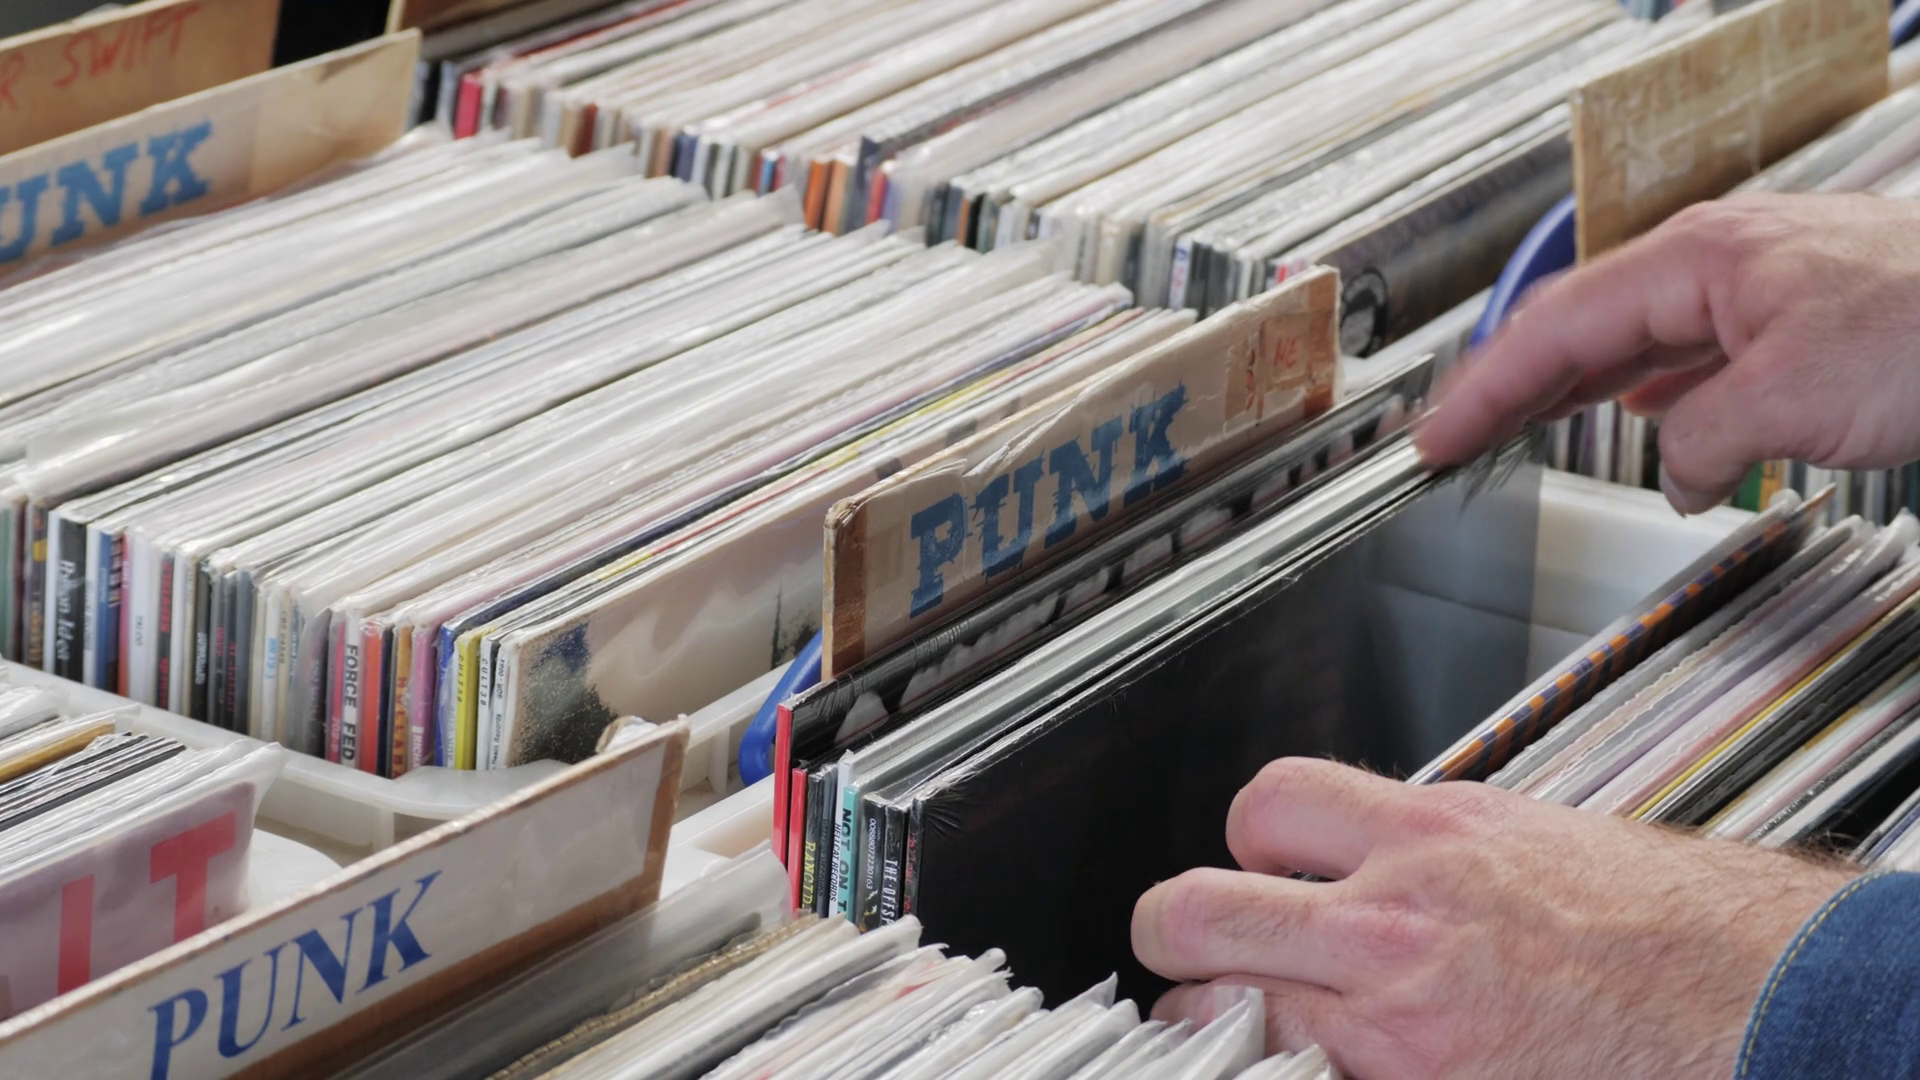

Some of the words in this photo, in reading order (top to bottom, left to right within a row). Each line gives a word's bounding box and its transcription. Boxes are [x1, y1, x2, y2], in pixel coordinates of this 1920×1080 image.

[53, 2, 201, 89] SWIFT
[910, 381, 1187, 619] PUNK
[56, 620, 75, 661] Idea
[345, 644, 358, 708] FORCE
[480, 658, 488, 706] CULT38
[342, 722, 356, 760] FED
[494, 713, 502, 743] Records
[832, 823, 841, 860] HELLCAT
[842, 808, 852, 851] NOT
[802, 840, 816, 904] RANCID
[839, 860, 849, 890] ON
[866, 818, 876, 890] 00888072230163
[883, 859, 898, 882] THE
[829, 861, 839, 902] RECORDS
[147, 869, 443, 1080] PUNK
